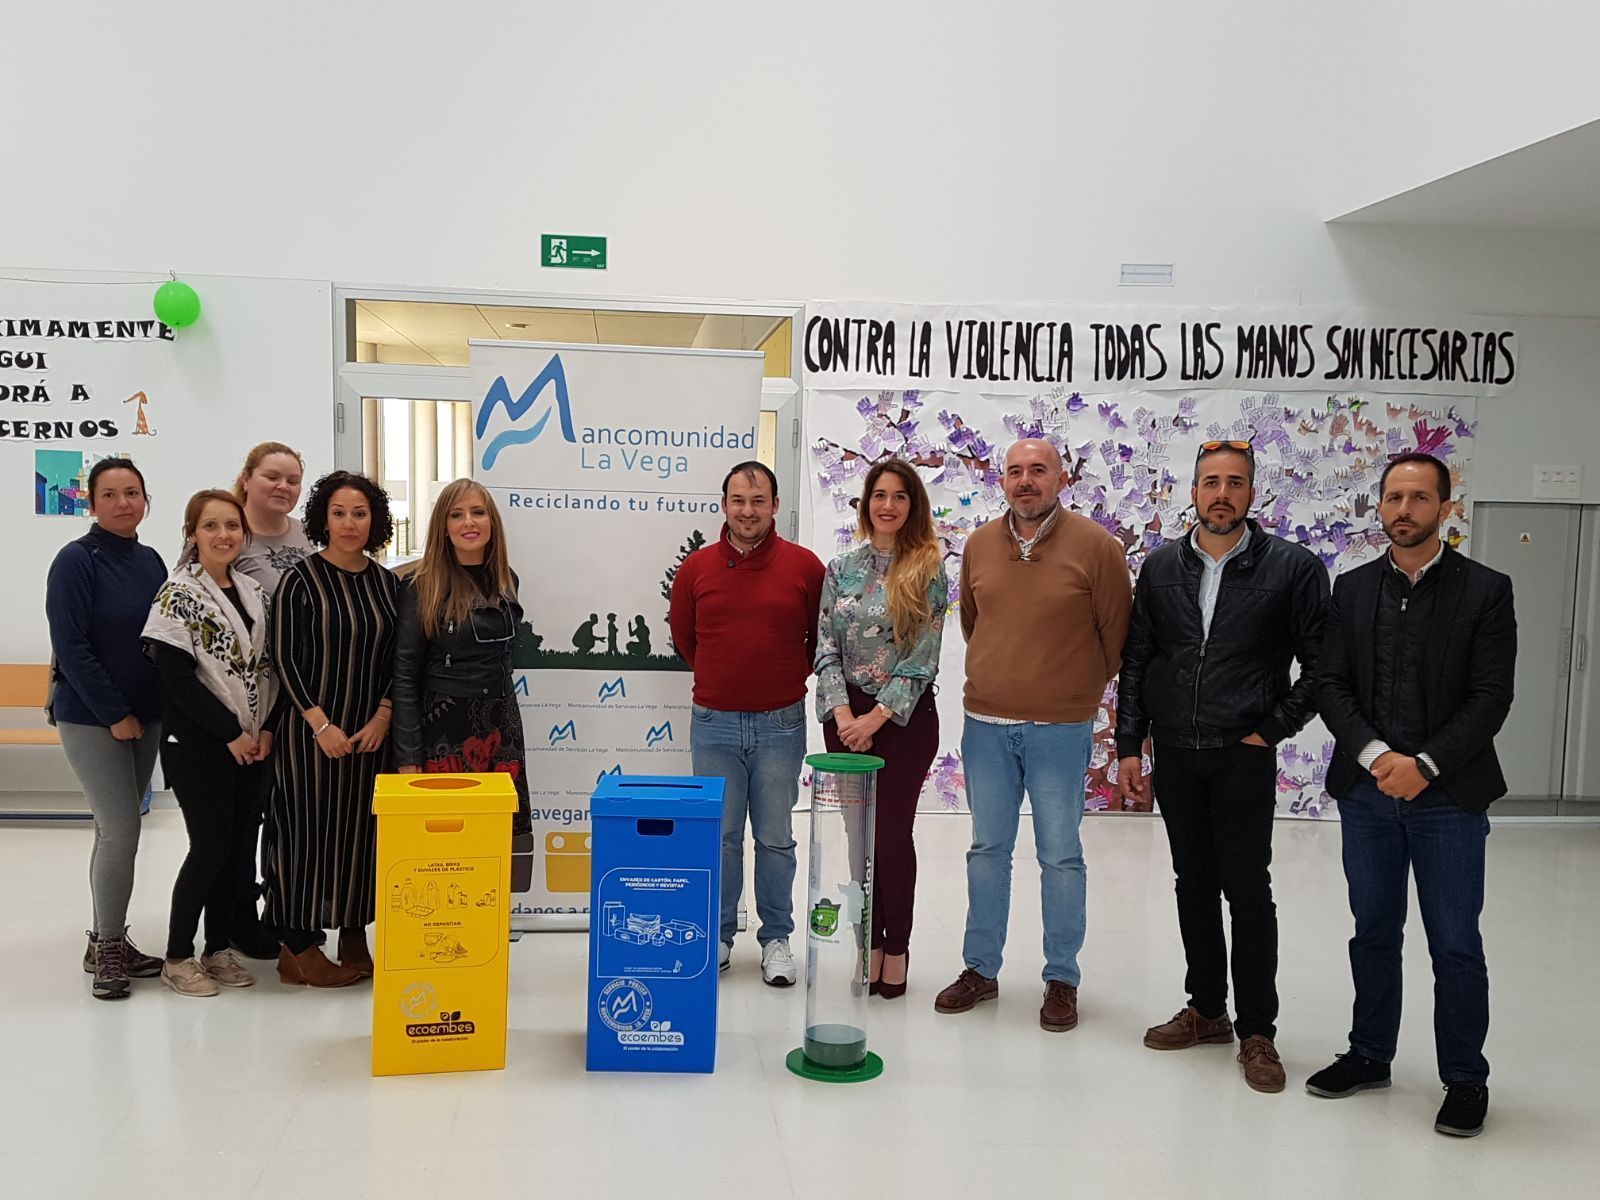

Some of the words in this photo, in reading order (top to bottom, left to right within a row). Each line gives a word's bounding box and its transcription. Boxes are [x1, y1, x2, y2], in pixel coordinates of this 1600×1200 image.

[0, 319, 175, 341] IMAMENTE
[804, 315, 895, 376] CONTRA
[909, 321, 932, 378] LA
[946, 320, 1072, 383] VIOLENCIA
[1090, 323, 1167, 382] TODAS
[1180, 322, 1224, 380] LAS
[1235, 324, 1315, 380] MANOS
[1324, 325, 1365, 380] SON
[1370, 328, 1514, 385] NECESARIAS
[70, 384, 90, 401] A
[581, 448, 611, 470] La
[620, 449, 688, 478] Vega
[509, 493, 620, 511] Reciclando
[629, 498, 648, 512] tu
[656, 497, 719, 513] futuro
[408, 1022, 473, 1035] ecoembes
[620, 1032, 682, 1043] ecoembes
